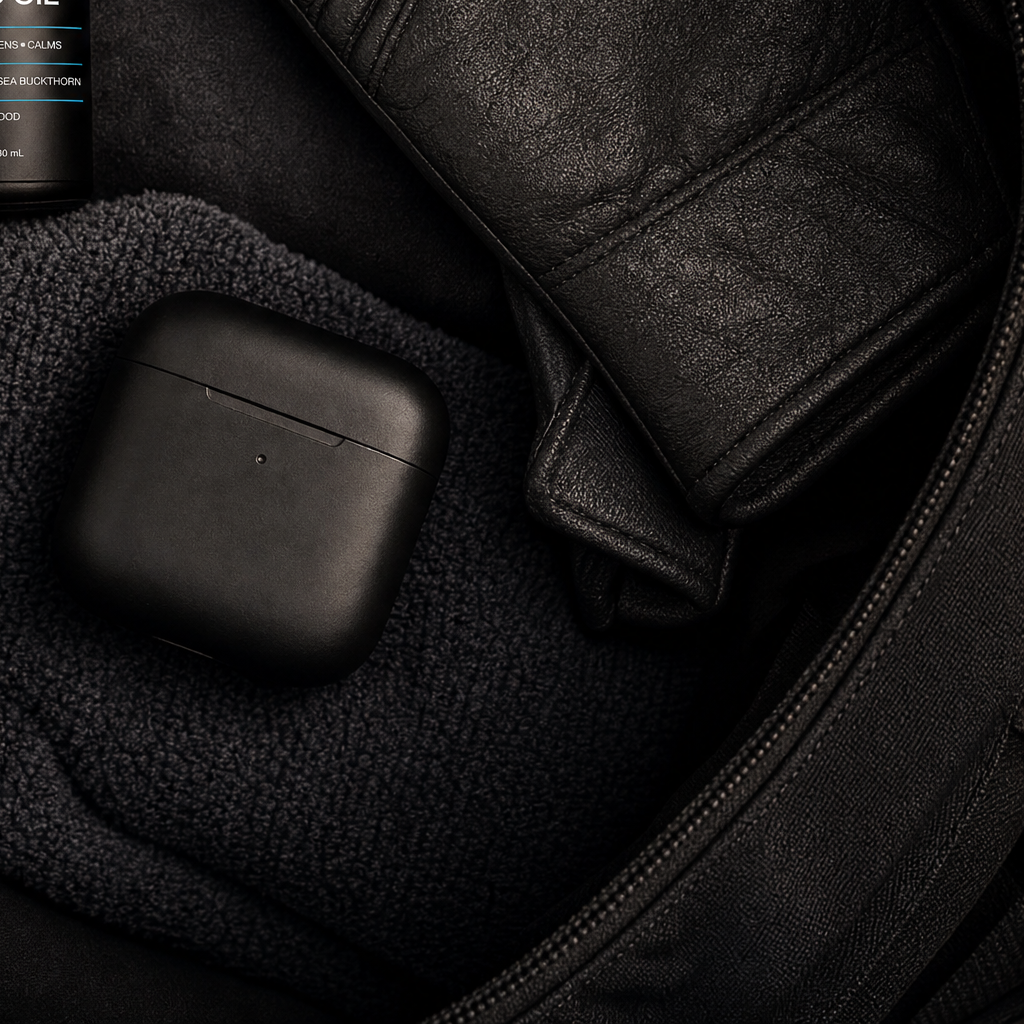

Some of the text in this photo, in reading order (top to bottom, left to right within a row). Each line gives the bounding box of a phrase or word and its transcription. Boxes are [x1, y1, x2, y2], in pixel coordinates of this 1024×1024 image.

[28, 41, 62, 50] CALMS
[20, 77, 81, 86] BUCKTHORN
[10, 149, 24, 157] mL
